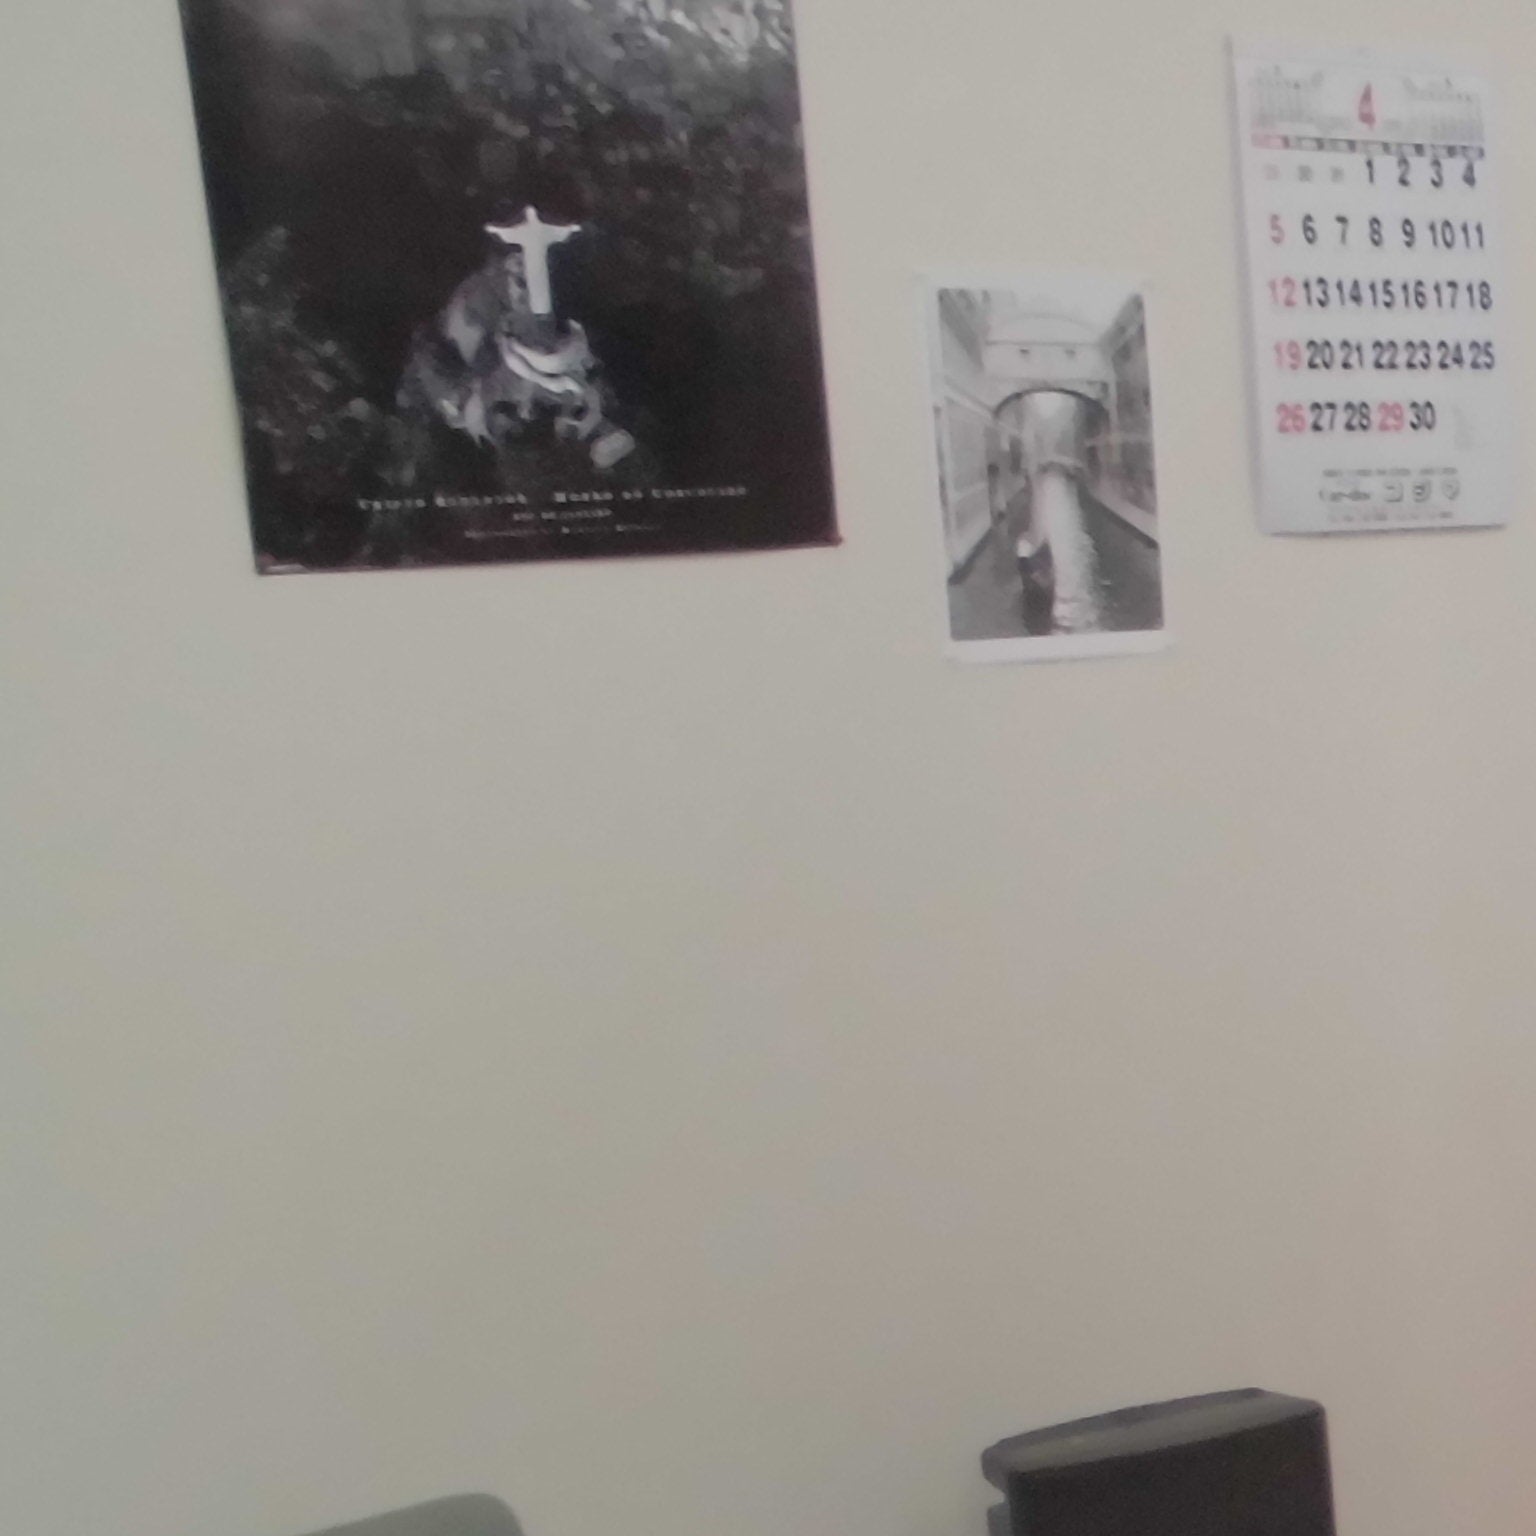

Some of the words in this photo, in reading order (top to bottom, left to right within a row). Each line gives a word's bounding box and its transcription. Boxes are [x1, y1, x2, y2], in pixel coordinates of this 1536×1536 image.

[1358, 81, 1377, 131] 4
[1366, 158, 1374, 184] 1
[1398, 157, 1411, 187] 2
[1430, 157, 1443, 188] 3
[1462, 160, 1476, 188] 4
[1270, 213, 1285, 245] 5
[1302, 214, 1317, 245] 6
[1335, 215, 1348, 245] 7
[1369, 216, 1383, 247] 8
[1402, 217, 1416, 248] 9
[1429, 219, 1455, 249] 10
[1460, 220, 1485, 249] 11
[1268, 276, 1297, 308] 12
[1303, 276, 1330, 308] 13
[1336, 278, 1363, 307] 14
[1369, 278, 1395, 308] 15
[1402, 279, 1427, 309] 16
[1434, 281, 1459, 309] 17
[1466, 281, 1493, 310] 18
[1273, 339, 1301, 370] 19
[1306, 339, 1334, 370] 20
[1340, 339, 1364, 370] 21
[1372, 339, 1399, 370] 22
[1404, 339, 1431, 370] 23
[1437, 339, 1464, 370] 24
[1469, 339, 1495, 370] 25
[1276, 402, 1306, 433] 26
[1309, 401, 1337, 432] 27
[1344, 401, 1371, 432] 28
[1377, 401, 1404, 432] 29
[1409, 400, 1436, 431] 30
